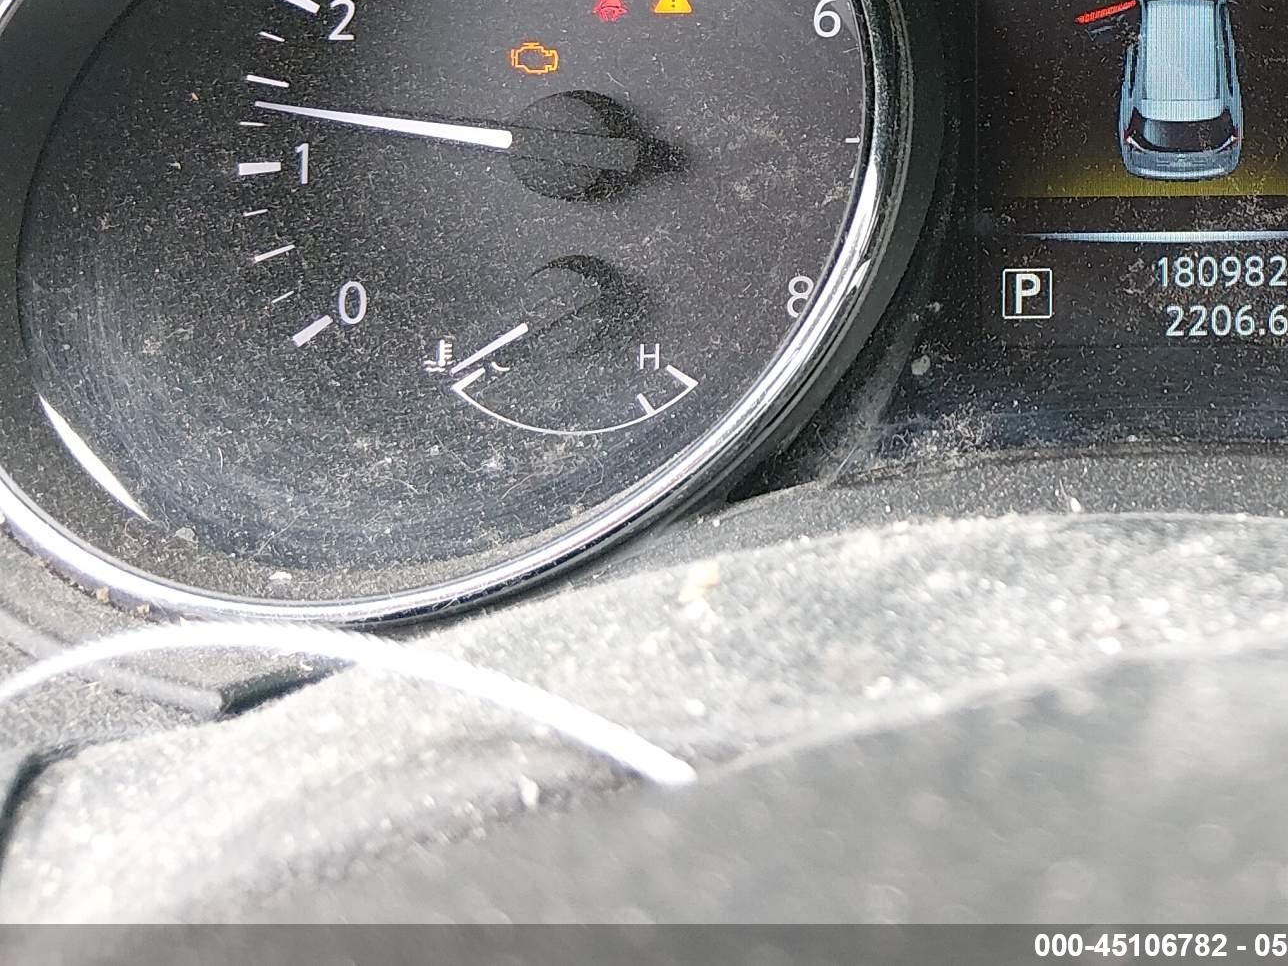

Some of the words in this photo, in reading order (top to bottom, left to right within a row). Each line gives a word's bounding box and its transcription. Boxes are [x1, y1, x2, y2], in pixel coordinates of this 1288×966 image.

[294, 142, 310, 185] 1
[1158, 254, 1288, 289] 180982
[338, 280, 368, 325] 0
[787, 275, 815, 319] 8
[1014, 273, 1041, 315] P
[639, 343, 661, 371] H
